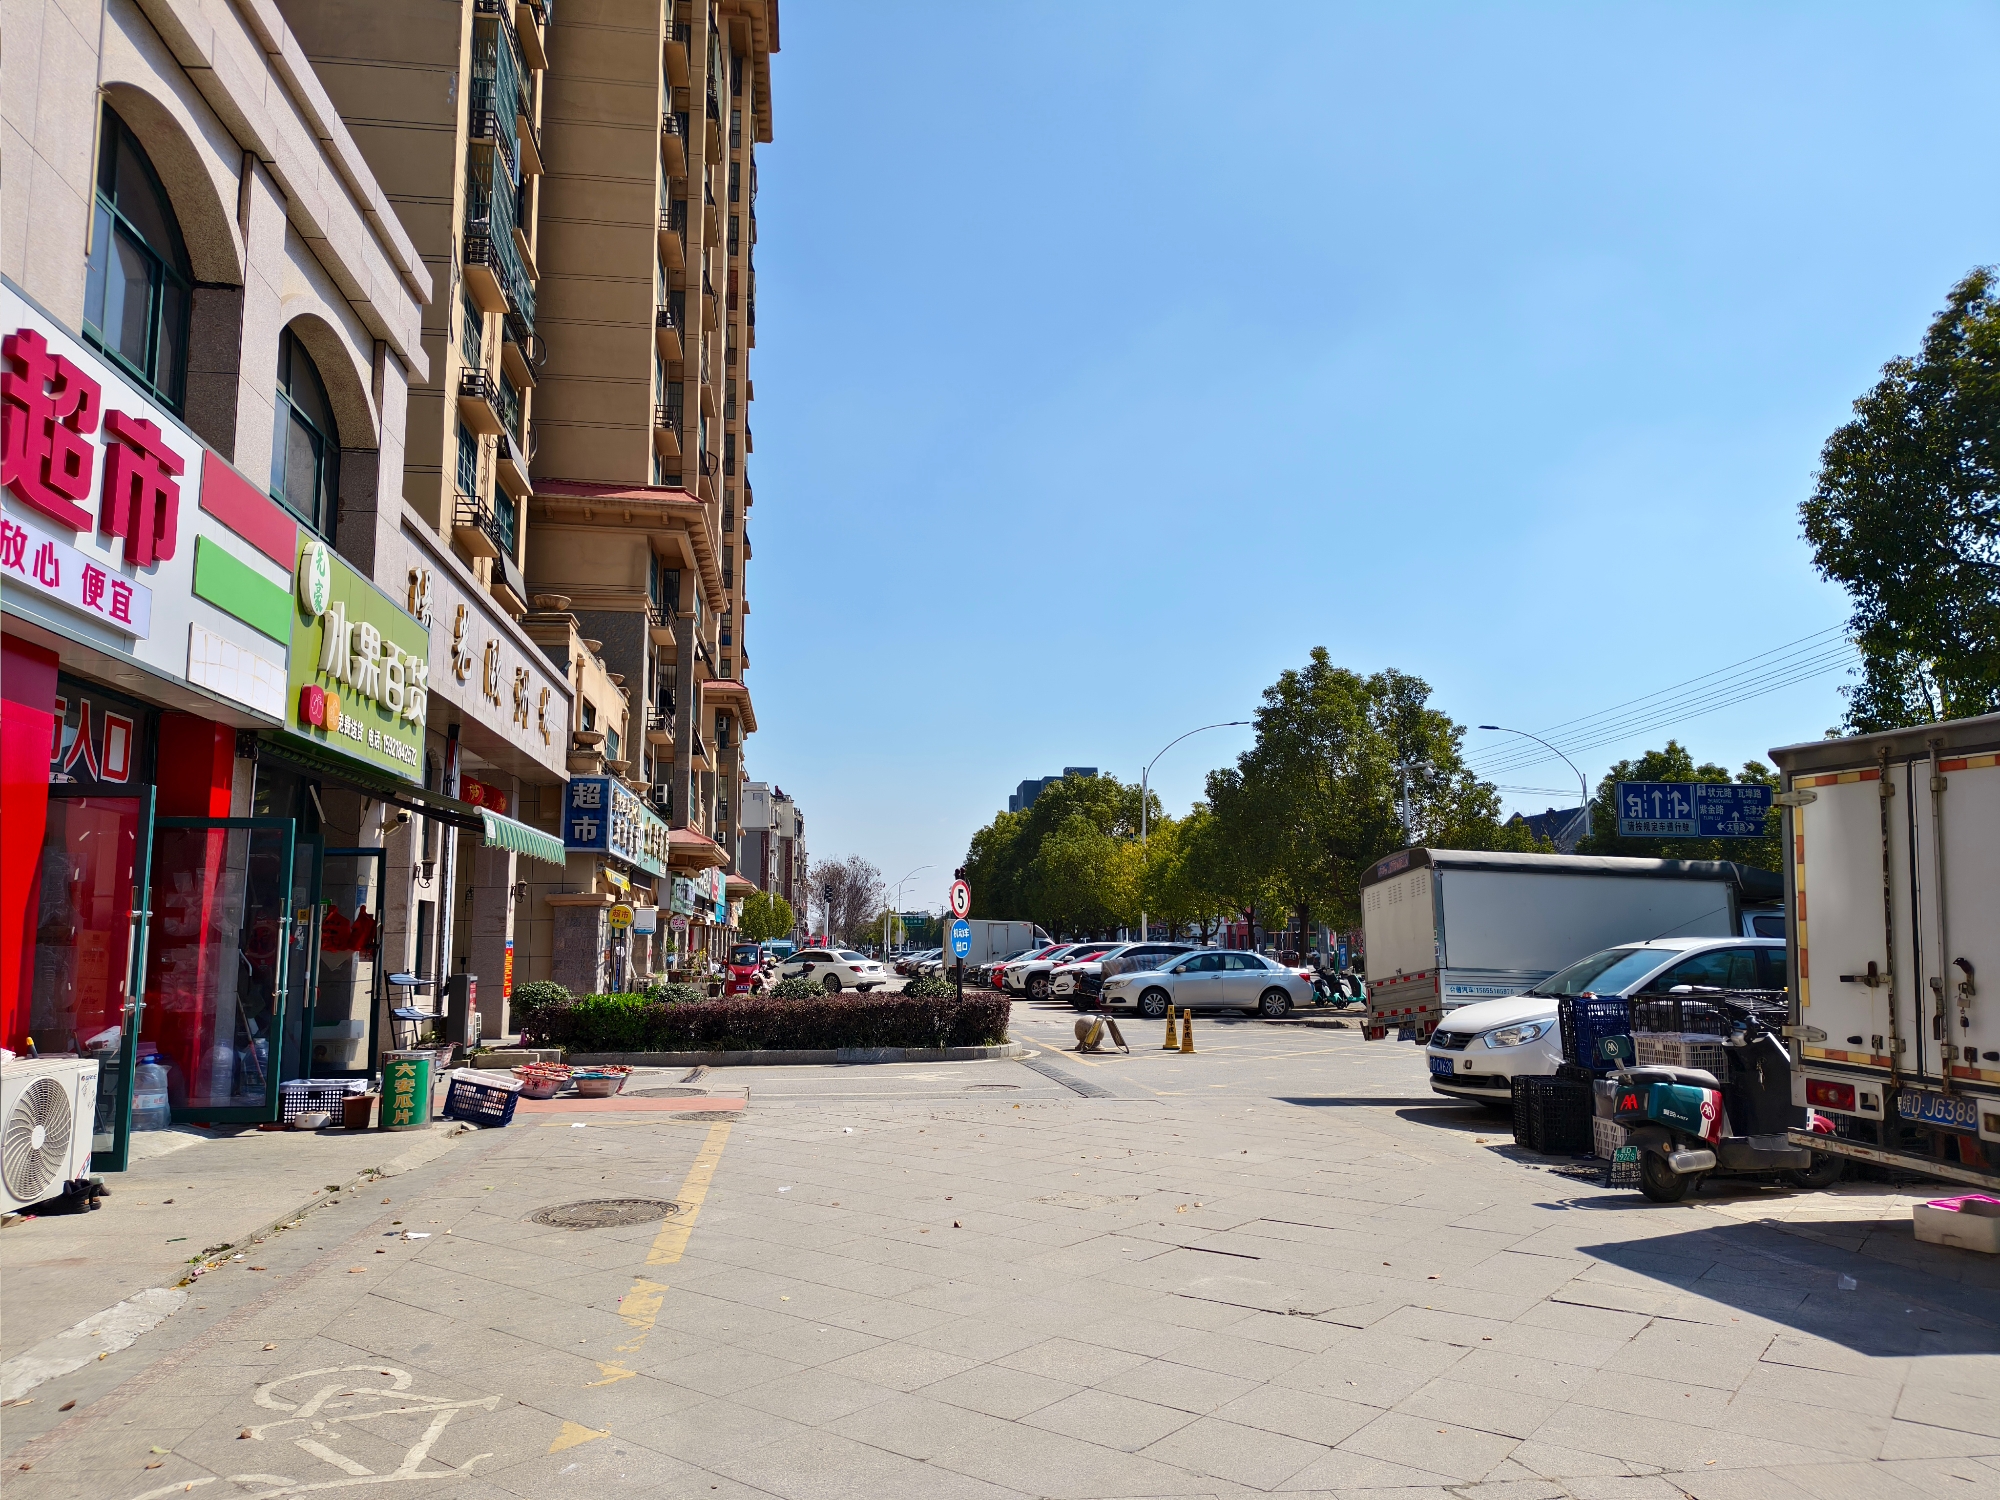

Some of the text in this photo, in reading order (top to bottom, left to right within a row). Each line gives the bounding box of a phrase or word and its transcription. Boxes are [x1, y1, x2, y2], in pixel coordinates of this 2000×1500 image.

[0, 327, 185, 567] 超市
[81, 563, 134, 625] 便宜
[318, 601, 429, 727] 水果百货
[338, 711, 364, 742] 免费送货
[572, 782, 602, 842] 超市
[1627, 821, 1690, 832] 请按规定车道行驶
[612, 909, 629, 919] 超市
[957, 888, 965, 910] 5
[954, 928, 970, 939] 机动车
[956, 941, 968, 952] 出口
[392, 1063, 417, 1125] 六安瓜片
